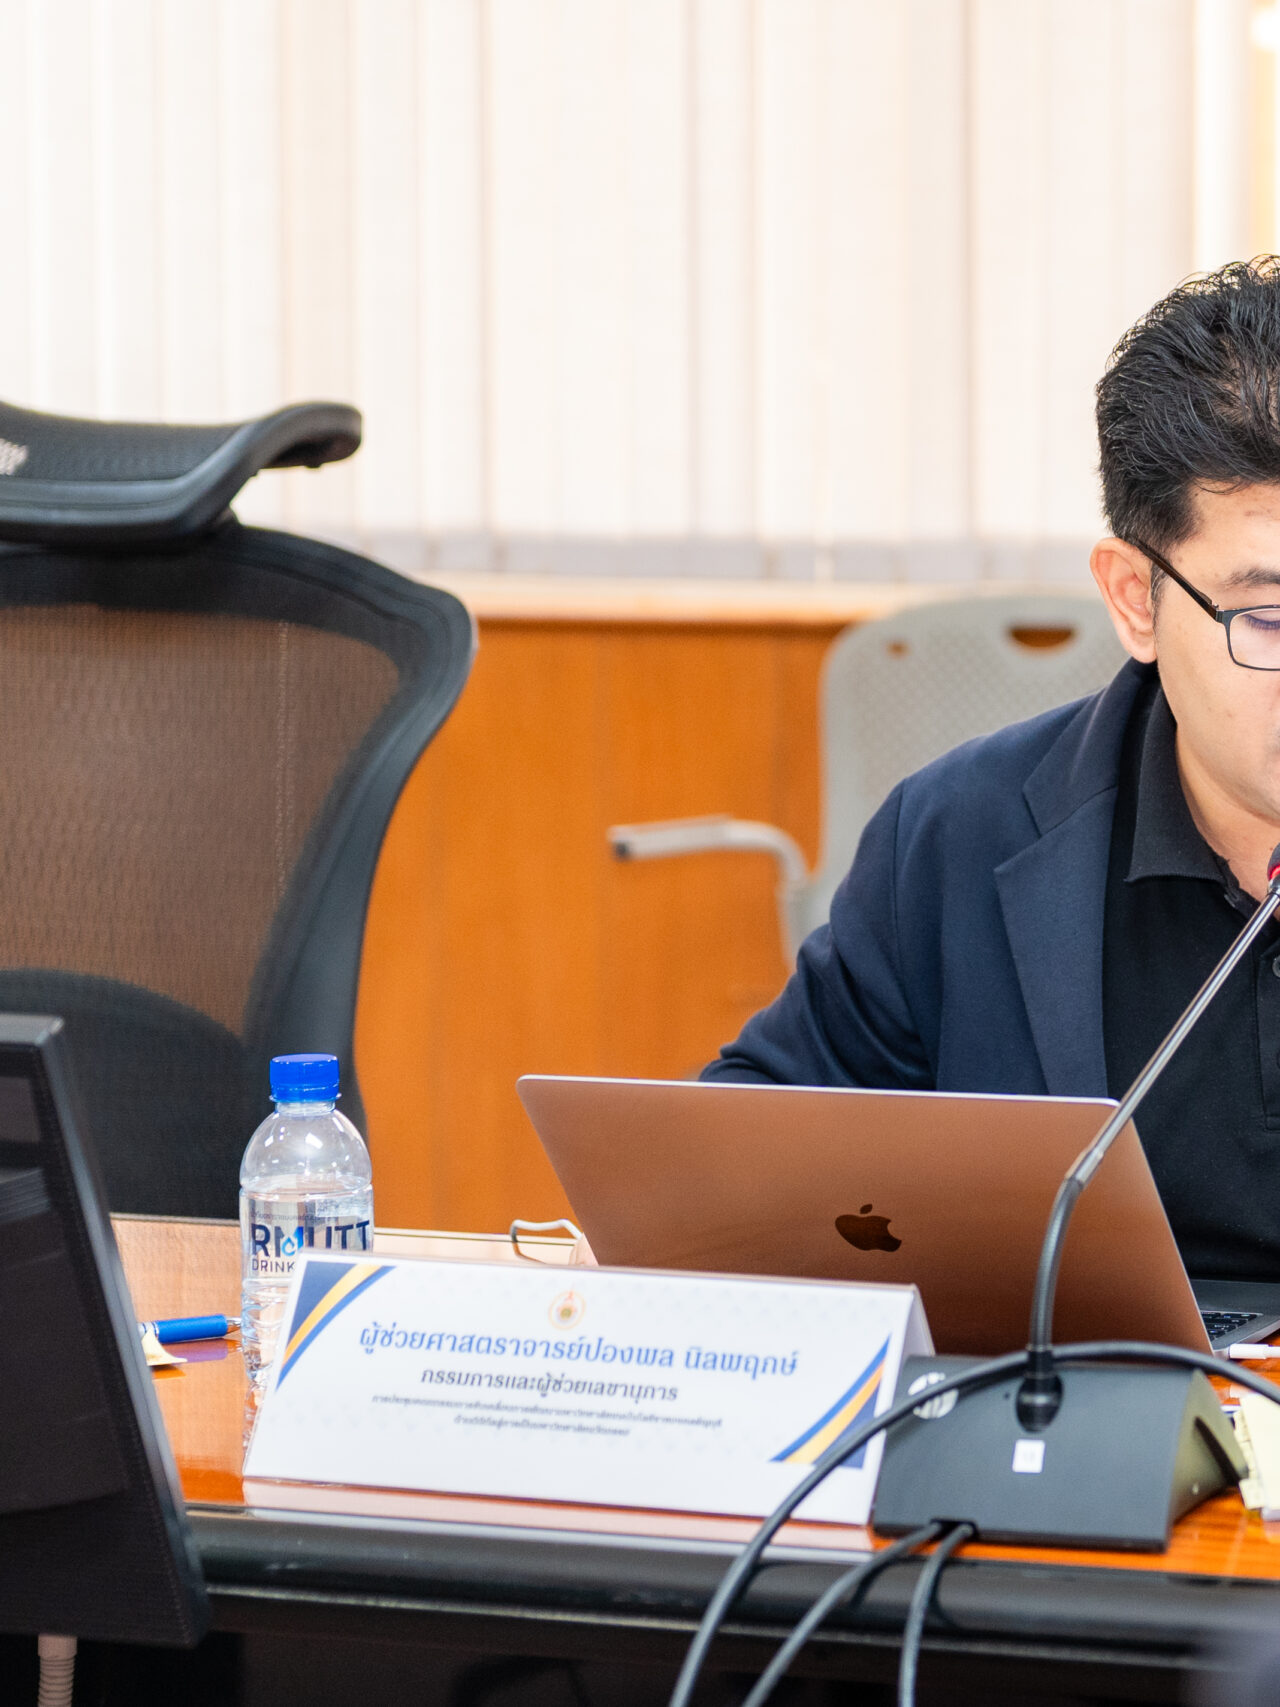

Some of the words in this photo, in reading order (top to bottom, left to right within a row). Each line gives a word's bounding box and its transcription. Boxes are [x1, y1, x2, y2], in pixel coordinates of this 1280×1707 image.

[251, 1258, 296, 1273] DRINK
[359, 1321, 675, 1368] ผู้ช่วยศาสตราจารย์ปองพล
[684, 1345, 801, 1381] นิลพฤกษ์
[421, 1367, 679, 1404] กรรมการและผู้ช่วยเลขานุการ
